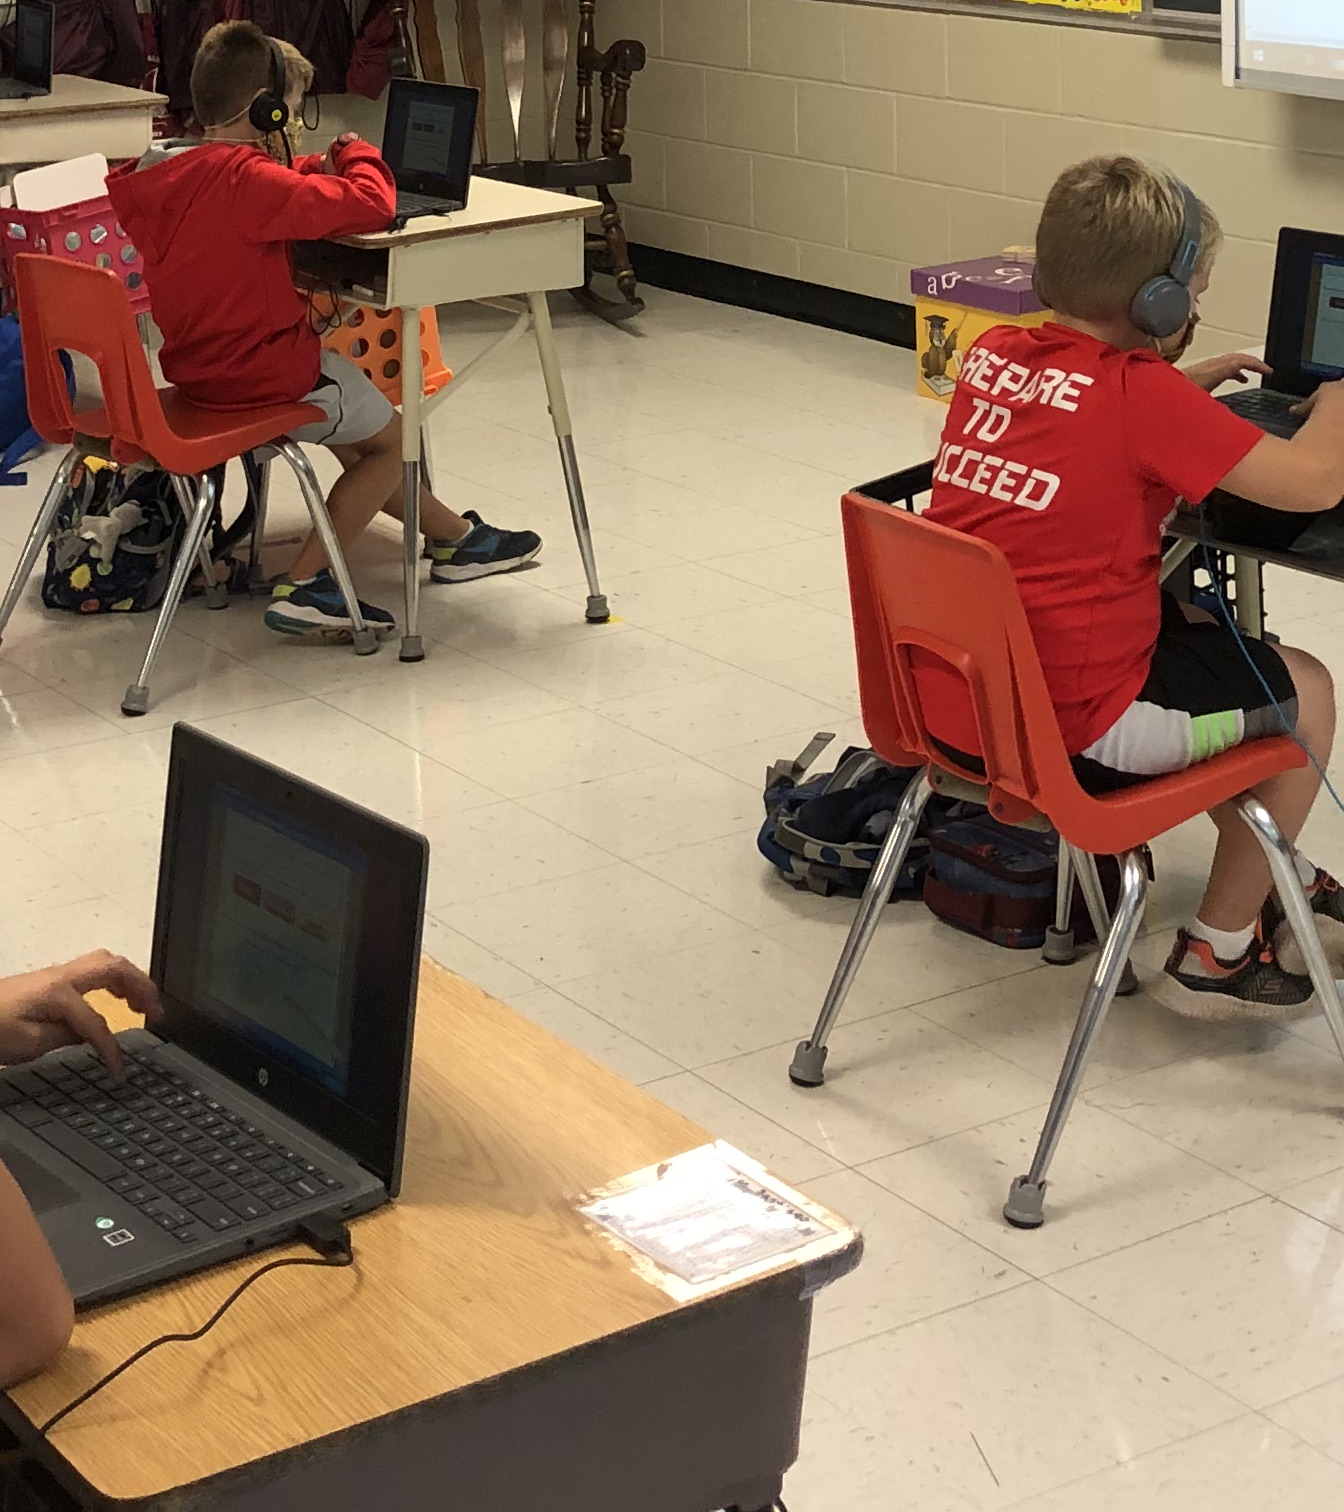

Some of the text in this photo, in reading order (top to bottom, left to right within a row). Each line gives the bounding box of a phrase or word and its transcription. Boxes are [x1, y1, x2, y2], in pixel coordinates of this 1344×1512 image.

[927, 276, 938, 296] a
[959, 346, 1095, 413] REPARE
[962, 398, 1012, 443] TO
